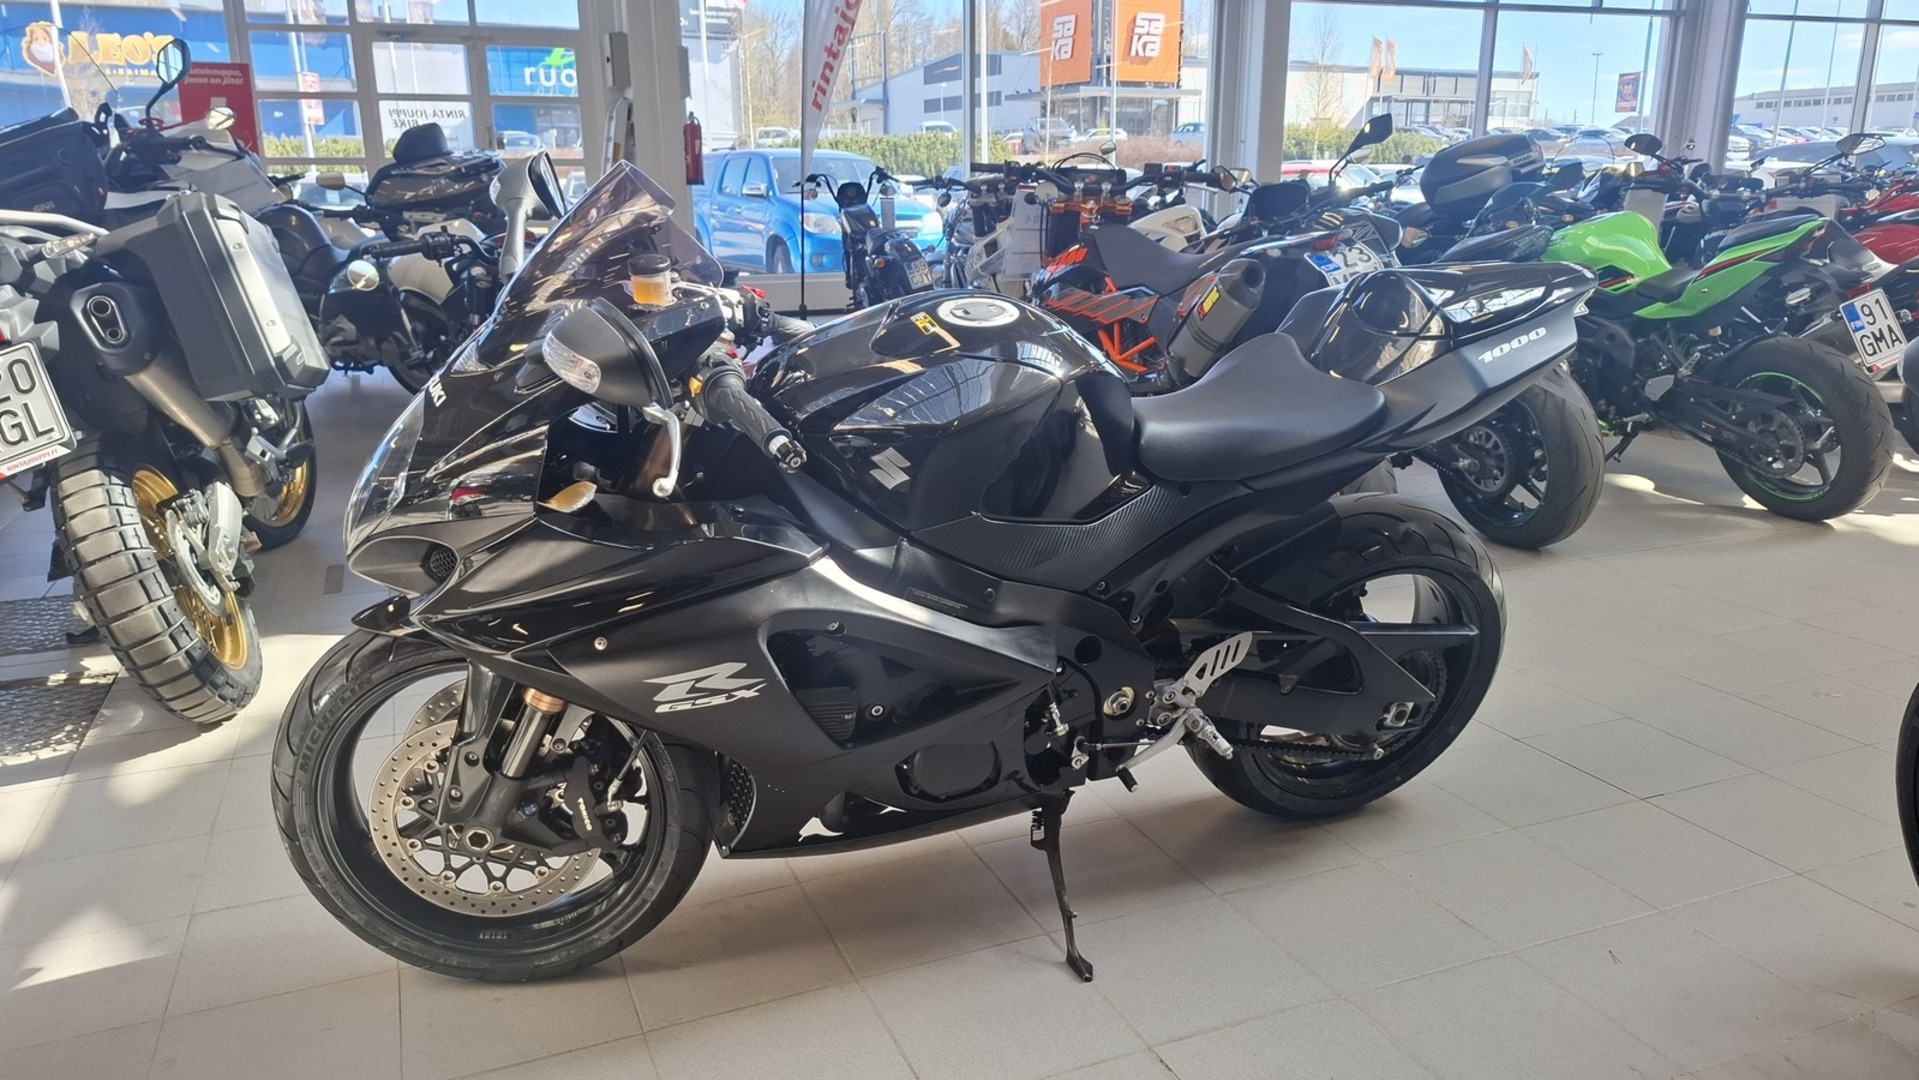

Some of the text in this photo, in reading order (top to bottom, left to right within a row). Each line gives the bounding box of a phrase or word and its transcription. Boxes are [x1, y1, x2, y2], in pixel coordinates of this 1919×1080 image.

[1860, 297, 1889, 326] 91
[1477, 327, 1547, 363] 1000
[1860, 323, 1904, 357] GMA
